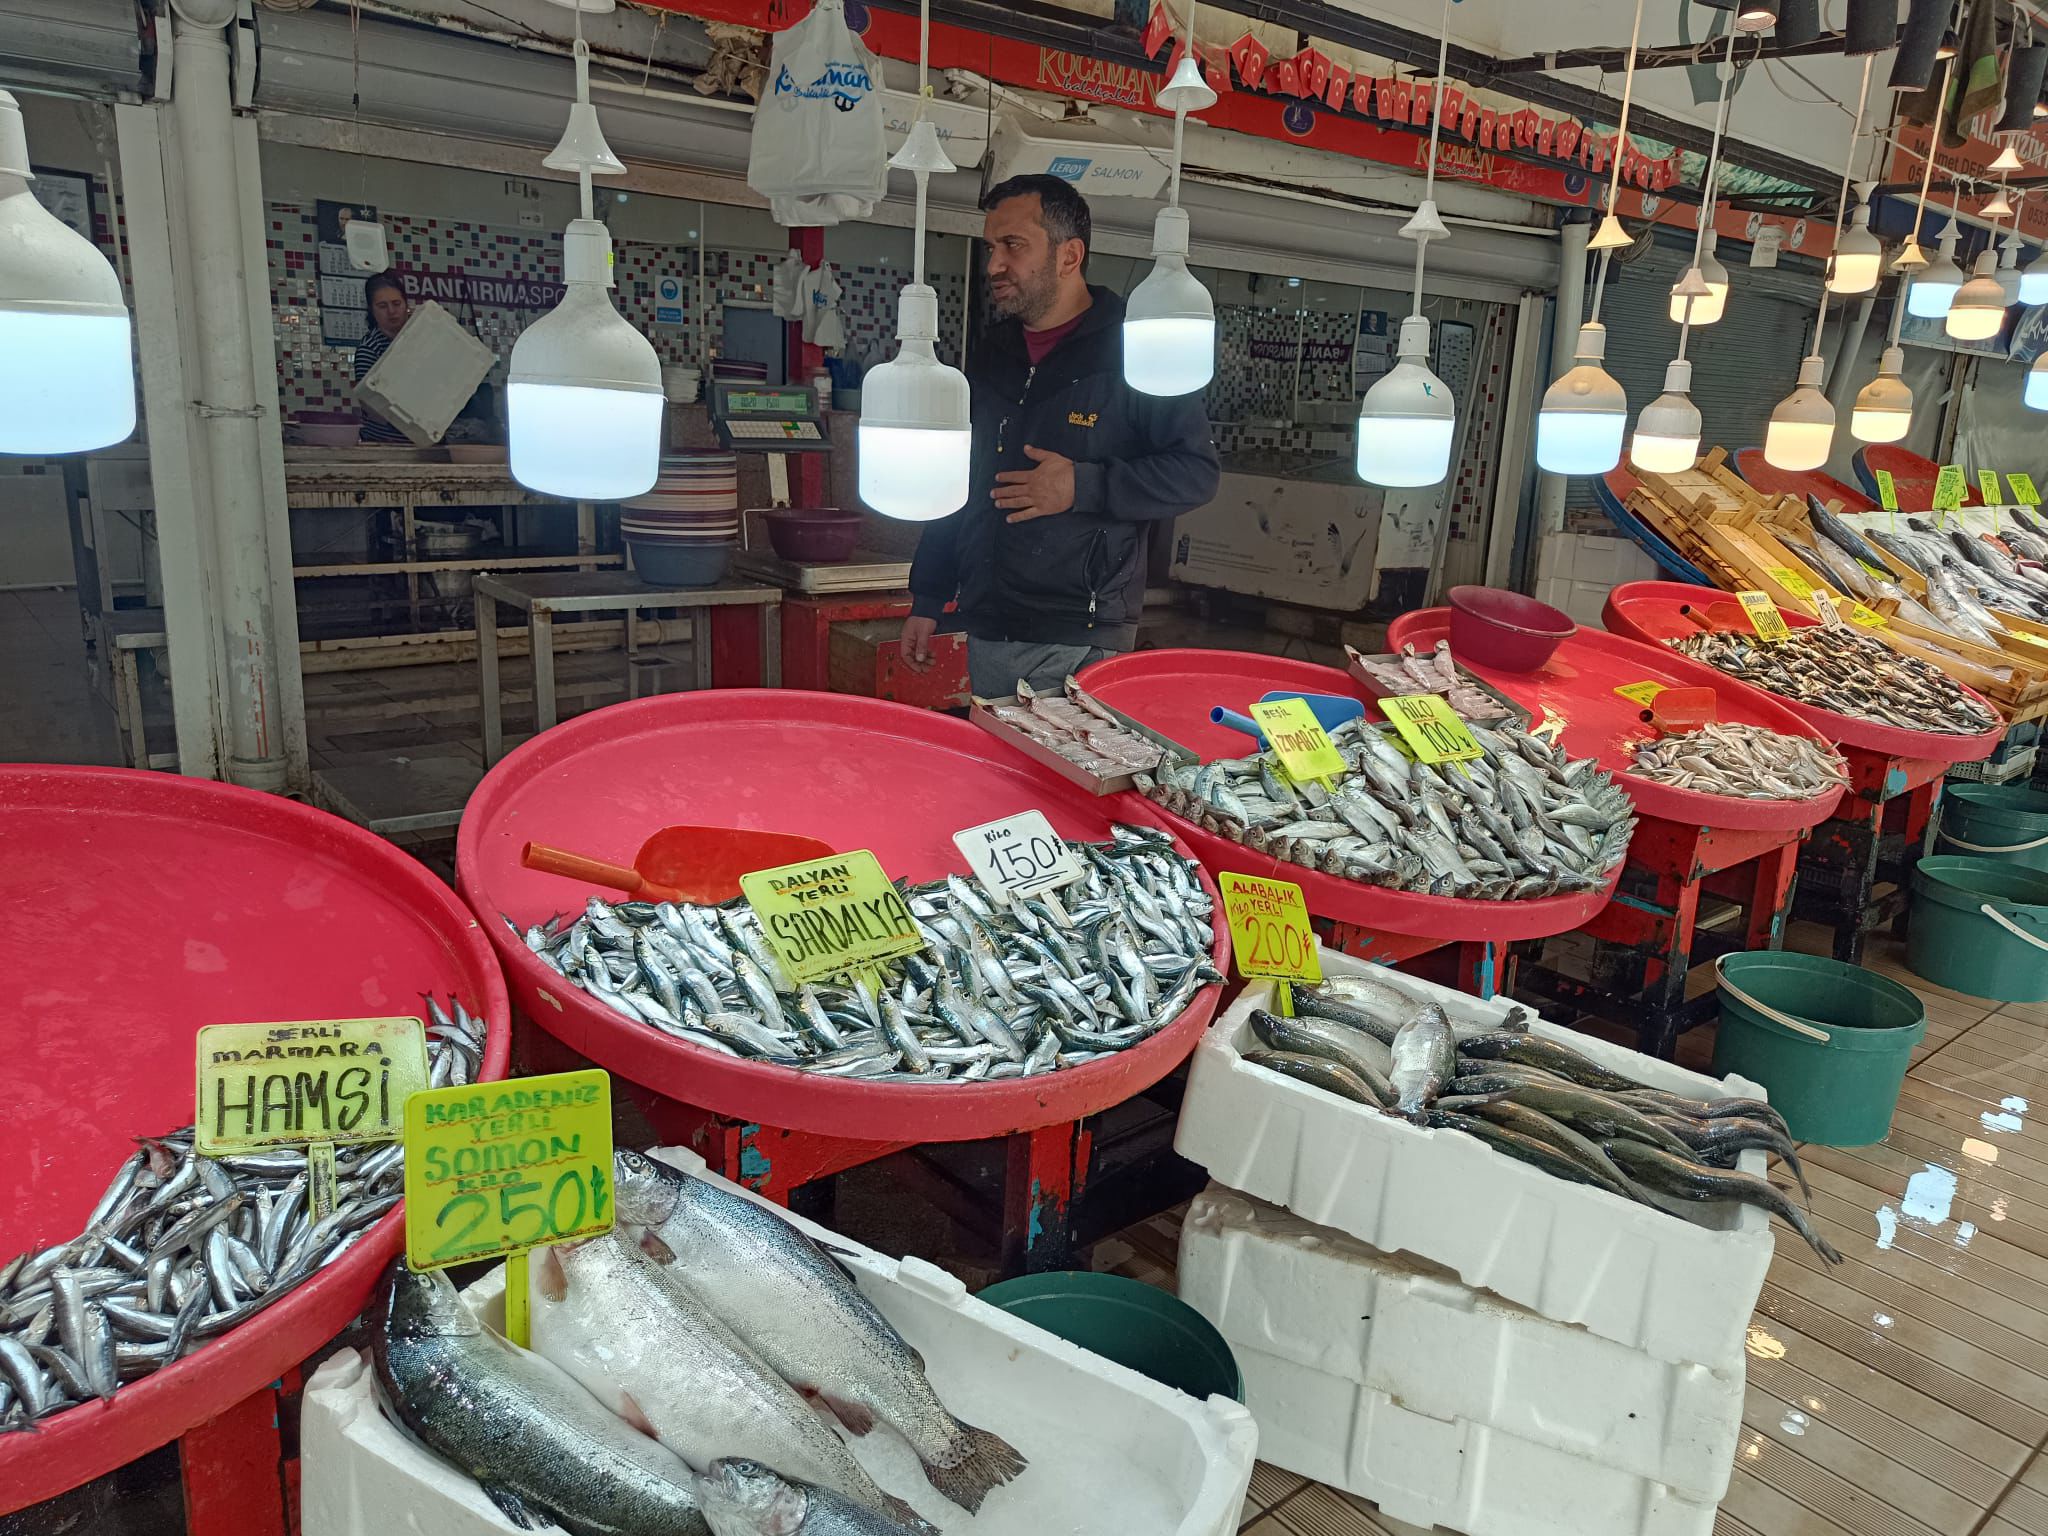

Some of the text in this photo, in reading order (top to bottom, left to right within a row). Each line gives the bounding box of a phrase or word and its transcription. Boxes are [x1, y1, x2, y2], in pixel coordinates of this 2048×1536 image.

[1914, 139, 1960, 174] Memet
[1091, 167, 1144, 180] SALMON
[1267, 723, 1326, 753] İZMARİT
[767, 864, 851, 892] DALYAN
[1232, 880, 1298, 906] ALABALIK
[770, 891, 915, 963] SARDALYA
[212, 1041, 383, 1064] MARMARA
[216, 1057, 392, 1137] HAMSİ
[424, 1133, 581, 1182] SOMON
